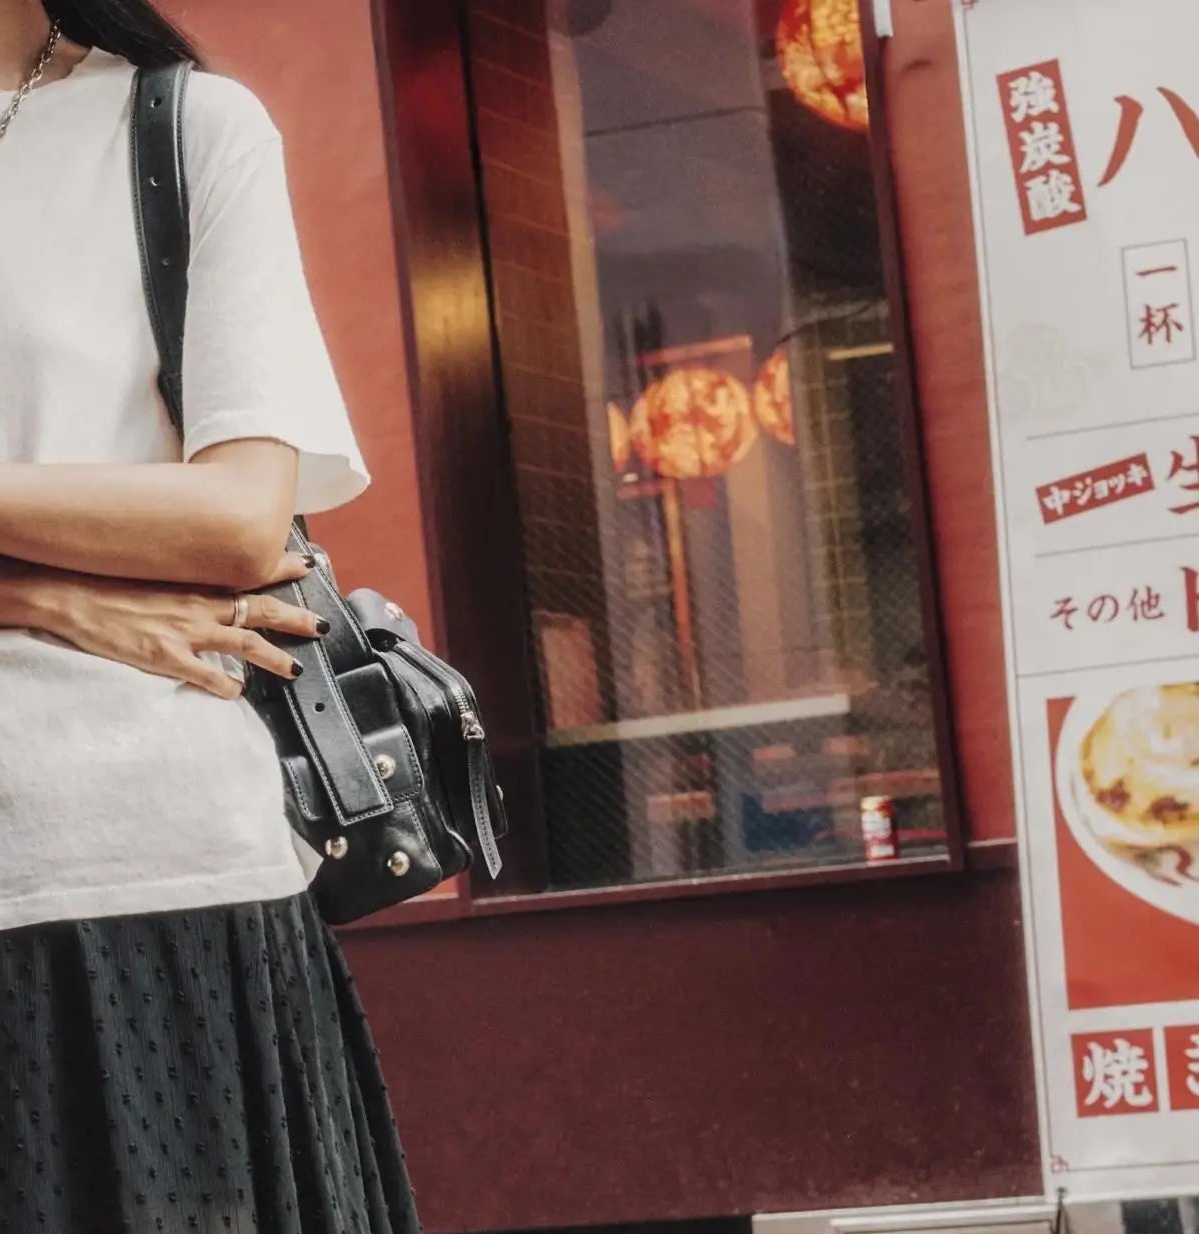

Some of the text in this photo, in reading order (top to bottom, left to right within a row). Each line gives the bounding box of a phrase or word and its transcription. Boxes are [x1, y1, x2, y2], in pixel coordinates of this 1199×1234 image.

[1009, 71, 1082, 221] 強炭酸
[1136, 263, 1183, 346] 一杯
[1042, 463, 1149, 515] 中ジョッキ
[1050, 585, 1166, 630] その他
